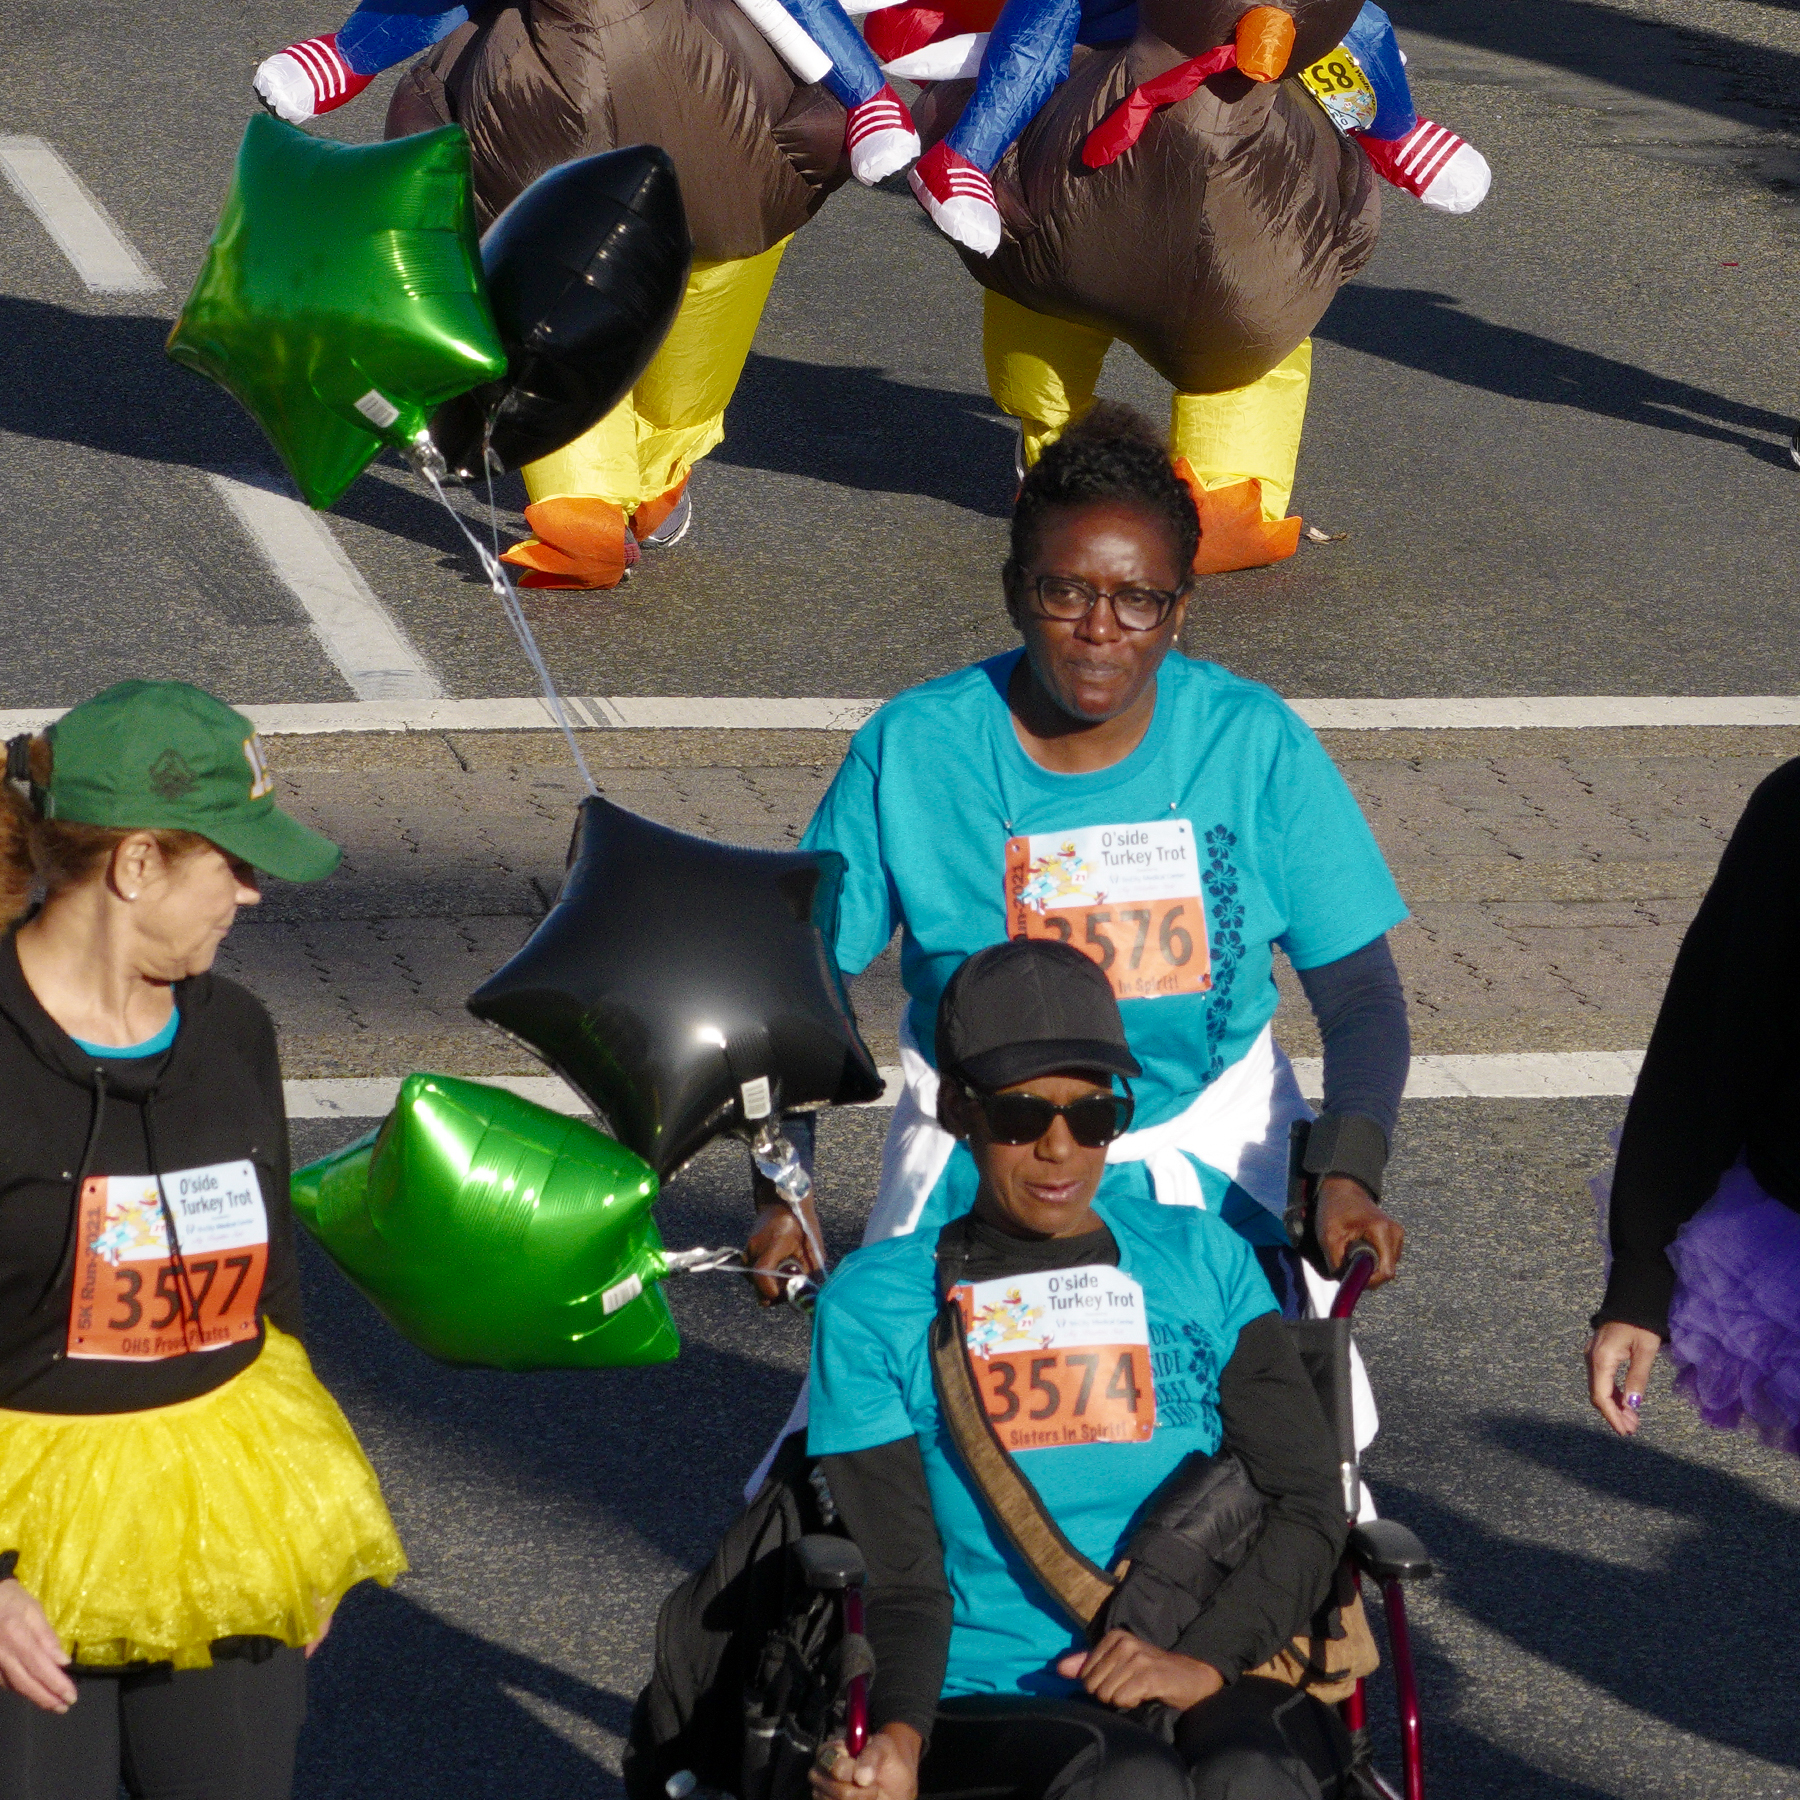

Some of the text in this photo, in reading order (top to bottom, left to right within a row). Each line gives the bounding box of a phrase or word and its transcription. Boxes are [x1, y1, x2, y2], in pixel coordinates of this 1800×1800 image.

[1101, 828, 1151, 846] O'side
[1100, 843, 1188, 865] Turkey Trot
[180, 1175, 219, 1195] O'side
[179, 1189, 254, 1216] Turkey Trot
[108, 1256, 253, 1330] 3577
[1048, 1273, 1099, 1293] O'side
[1048, 1290, 1136, 1312] Turkey Trot
[77, 1293, 93, 1332] 5K
[121, 1336, 150, 1352] OHS
[987, 1351, 1143, 1425] 3574
[1009, 1420, 1128, 1446] Sisters In Spirit!
